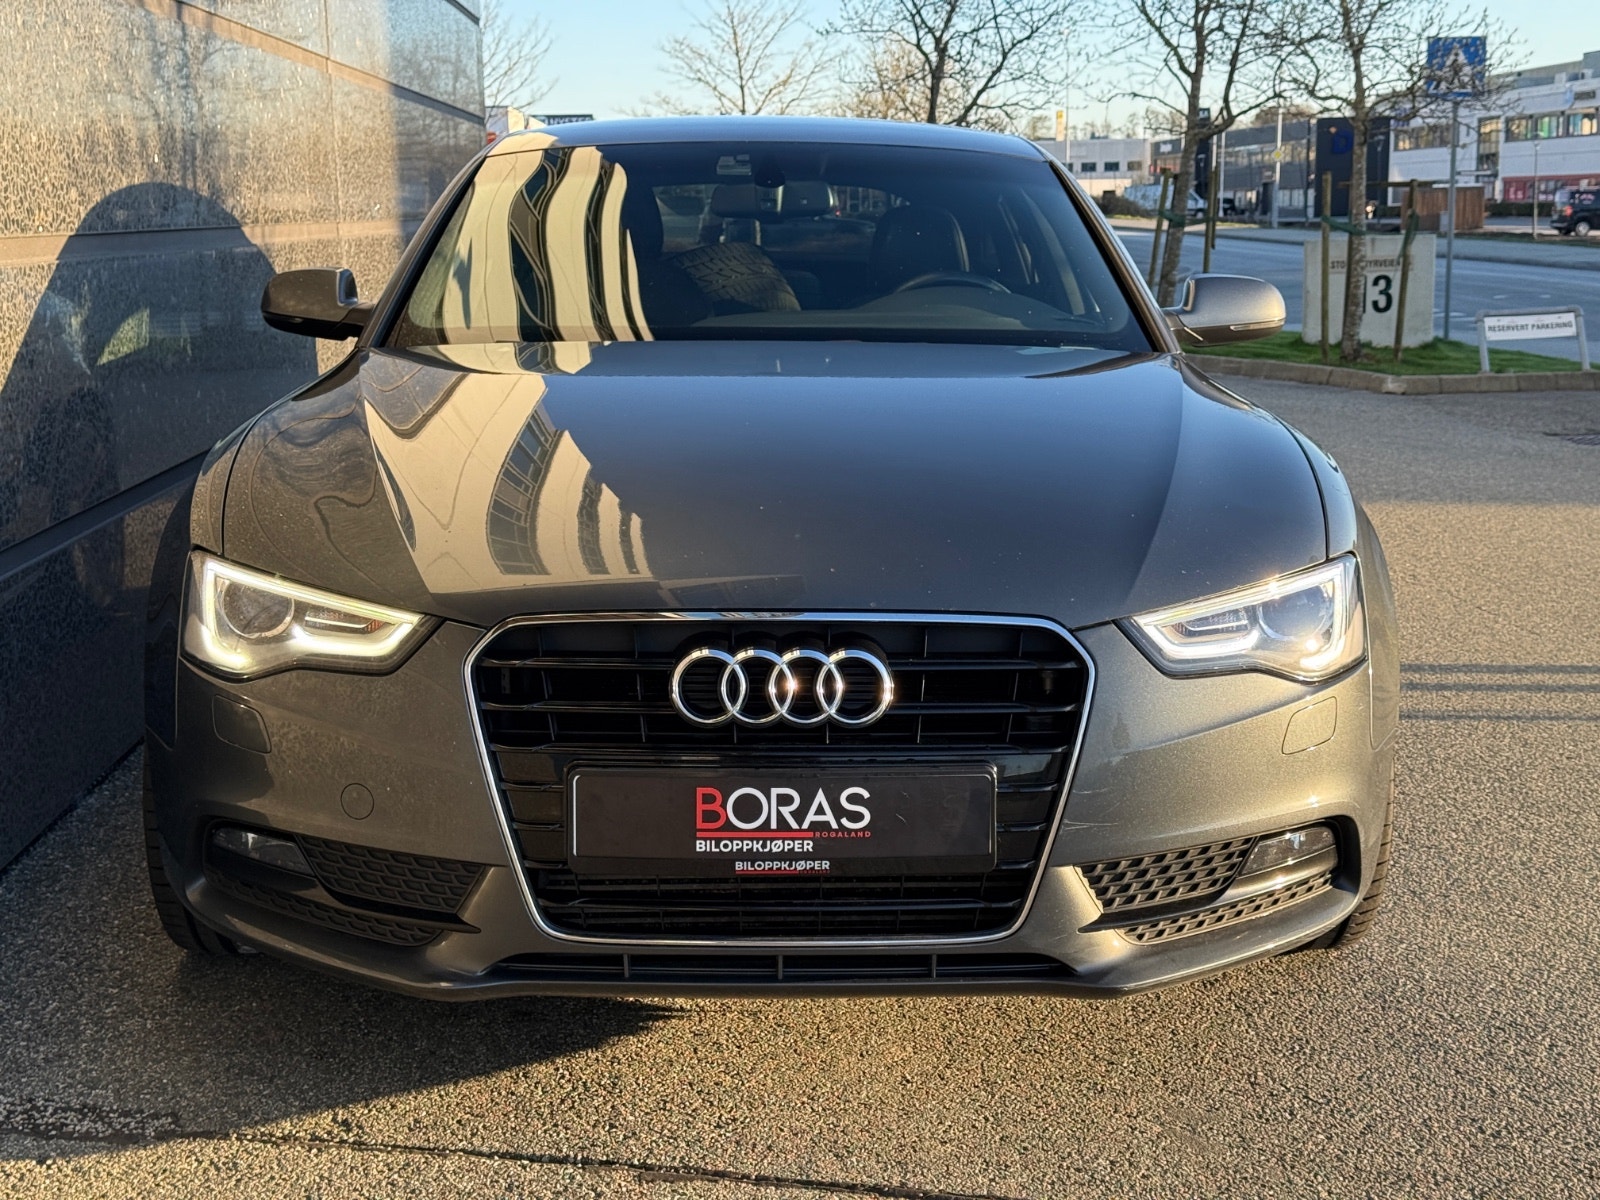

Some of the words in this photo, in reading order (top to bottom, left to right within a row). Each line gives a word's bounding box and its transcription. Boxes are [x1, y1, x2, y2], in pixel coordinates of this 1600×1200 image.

[1488, 324, 1529, 332] RESERVERT
[1531, 321, 1573, 330] PARKERING
[696, 787, 871, 830] BORAS
[695, 840, 813, 852] BILOPPKJØPER
[735, 860, 830, 871] BILOPPKJØPER
